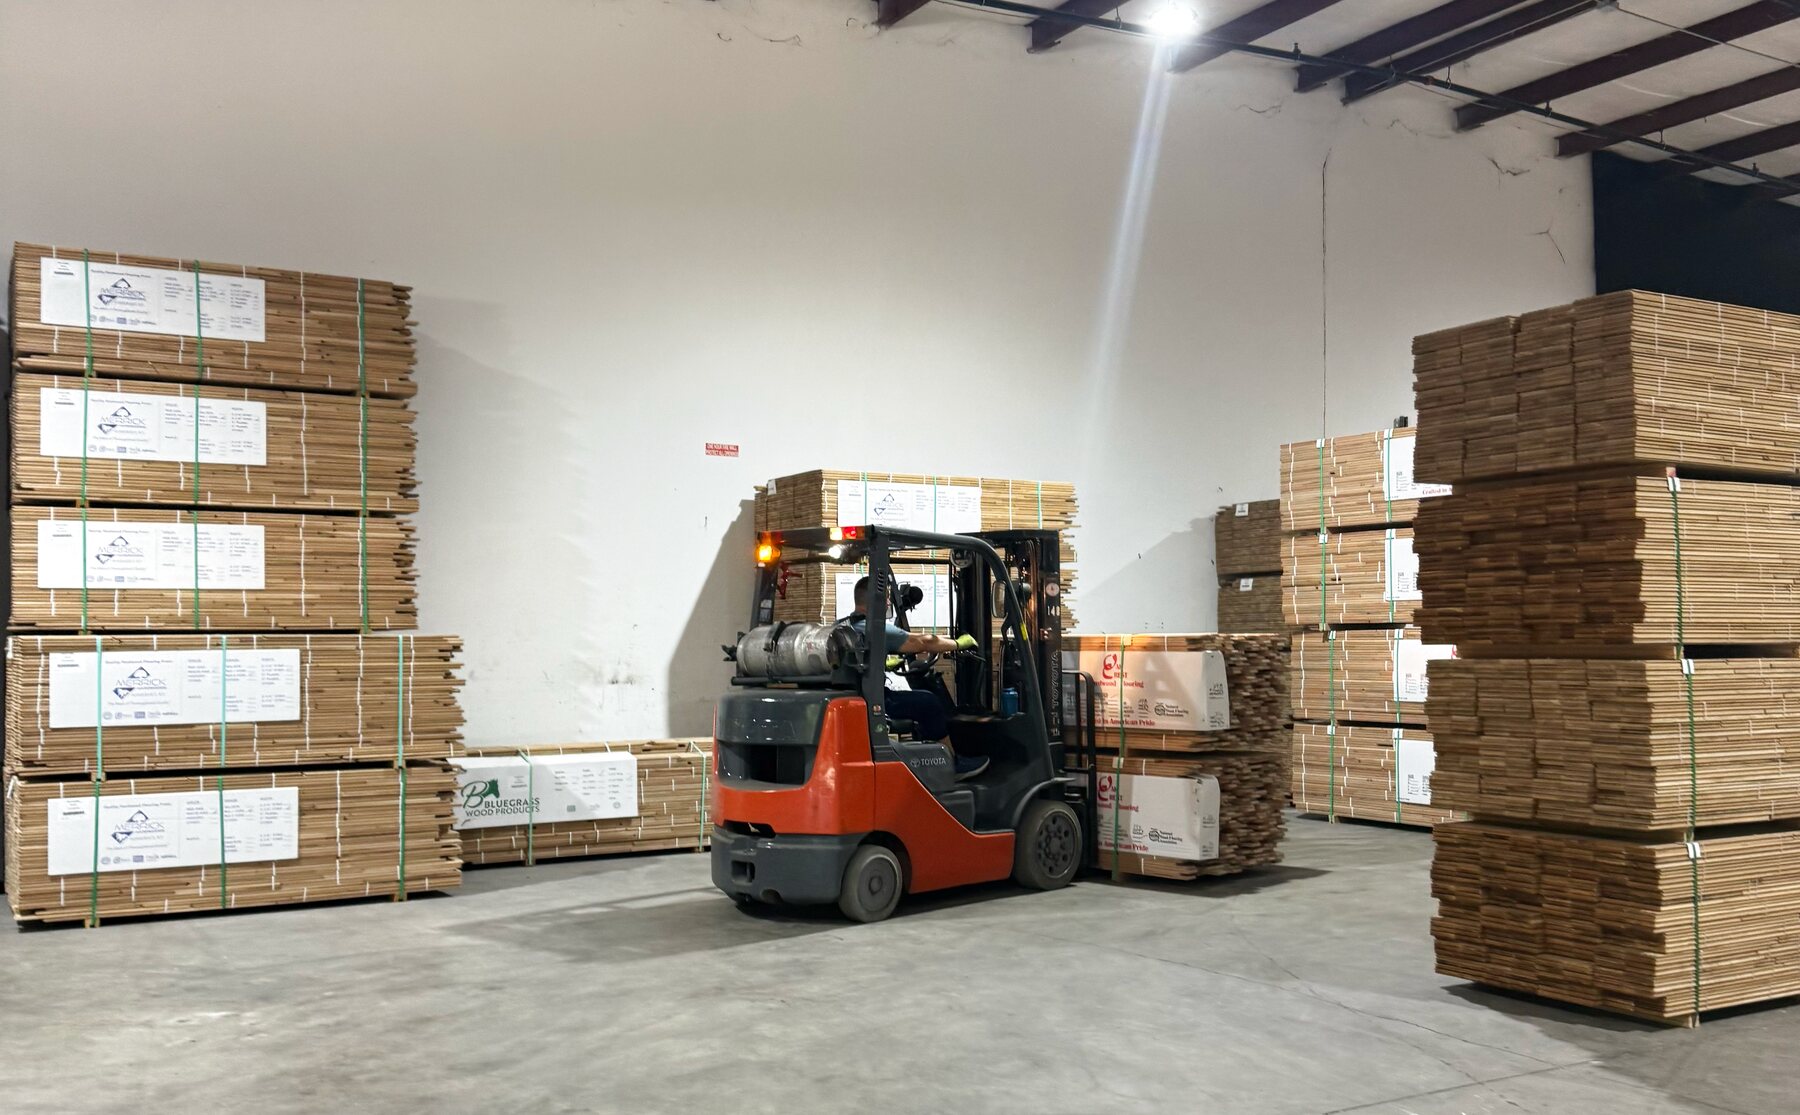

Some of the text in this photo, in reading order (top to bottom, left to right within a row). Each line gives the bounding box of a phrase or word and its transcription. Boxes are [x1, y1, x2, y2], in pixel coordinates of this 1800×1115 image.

[920, 757, 947, 766] TOYOTA
[484, 797, 540, 809] BLUEGRASS
[465, 805, 540, 817] WOOD PRODUCTS
